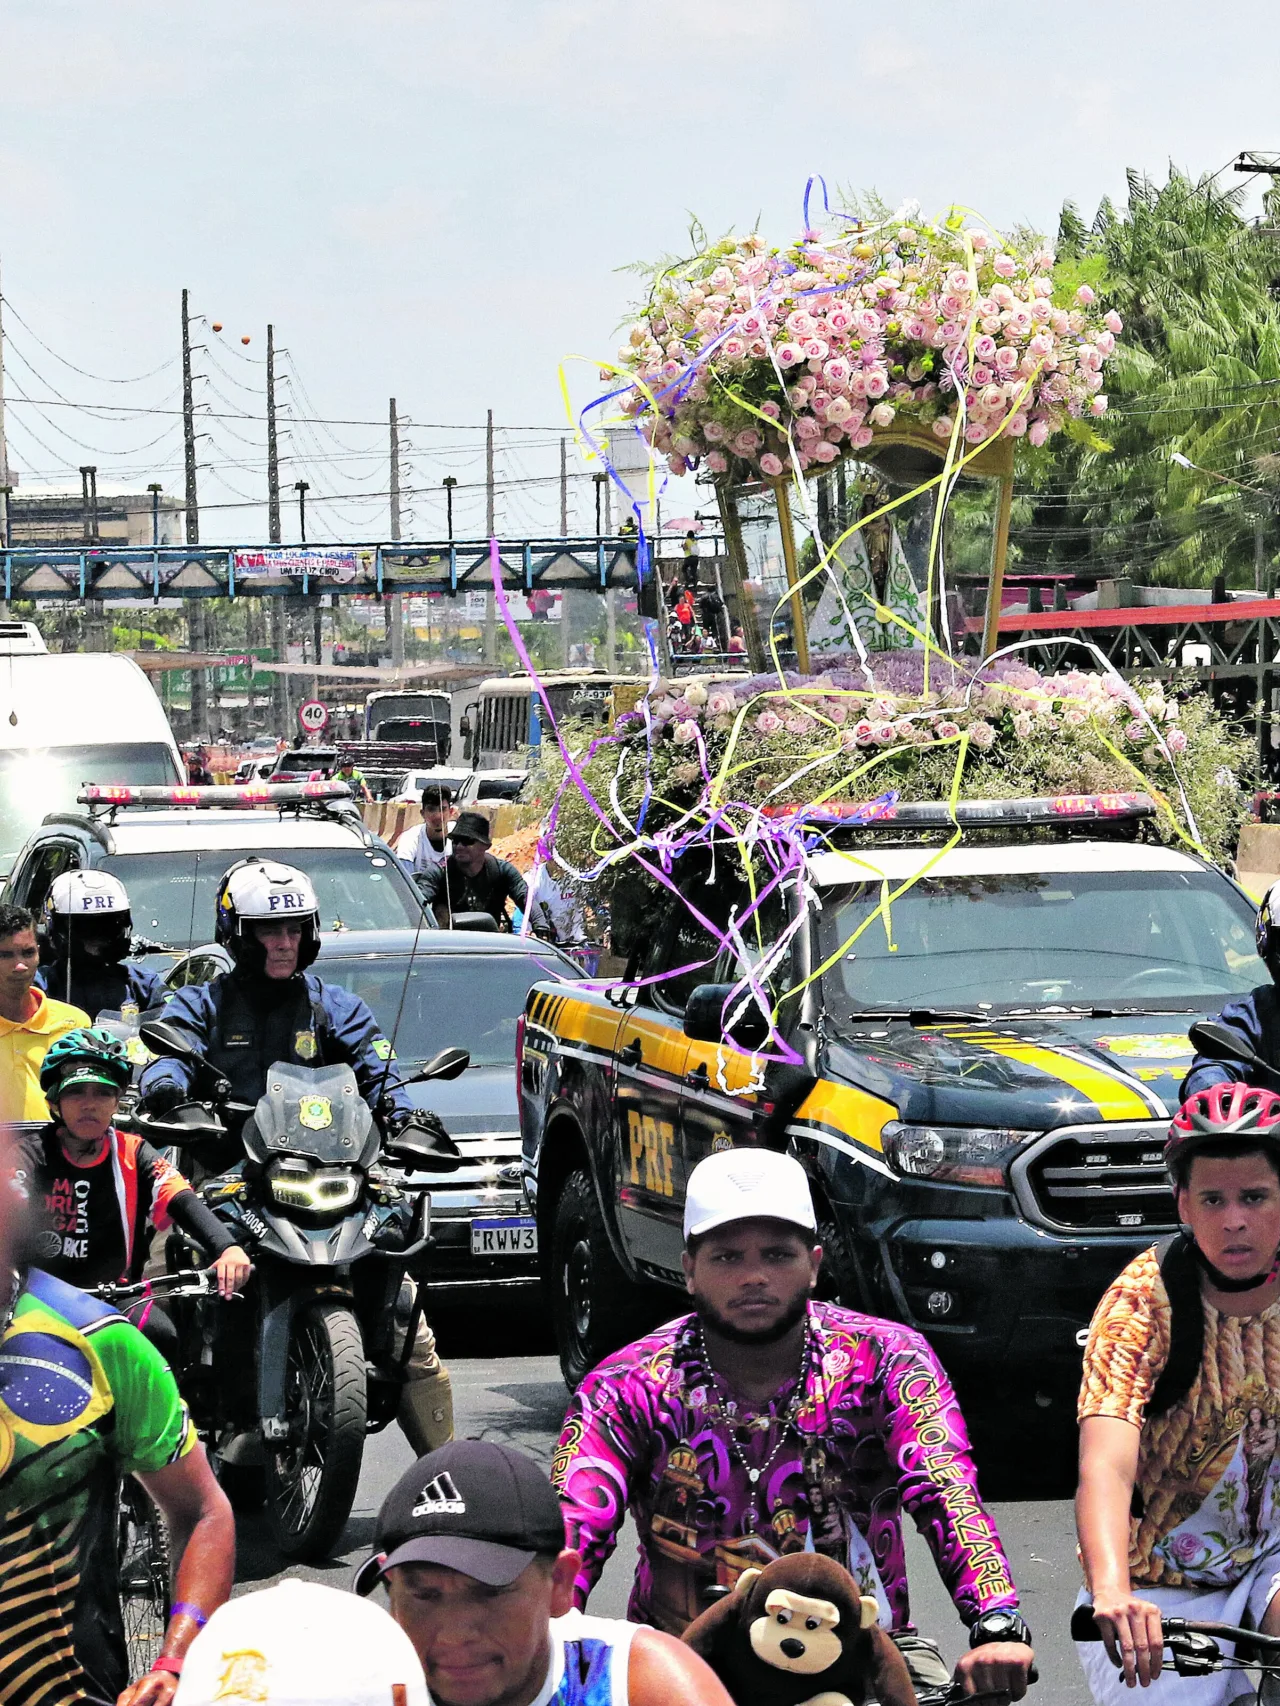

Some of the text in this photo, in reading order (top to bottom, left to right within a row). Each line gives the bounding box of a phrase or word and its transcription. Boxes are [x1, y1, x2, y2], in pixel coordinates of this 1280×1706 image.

[235, 553, 266, 568] KVA
[304, 707, 322, 719] 40
[82, 896, 115, 909] PRF
[268, 893, 304, 910] PRF
[628, 1109, 674, 1197] PRF
[240, 1209, 269, 1239] 20051
[924, 1452, 964, 1487] DE
[412, 1502, 466, 1517] adidas
